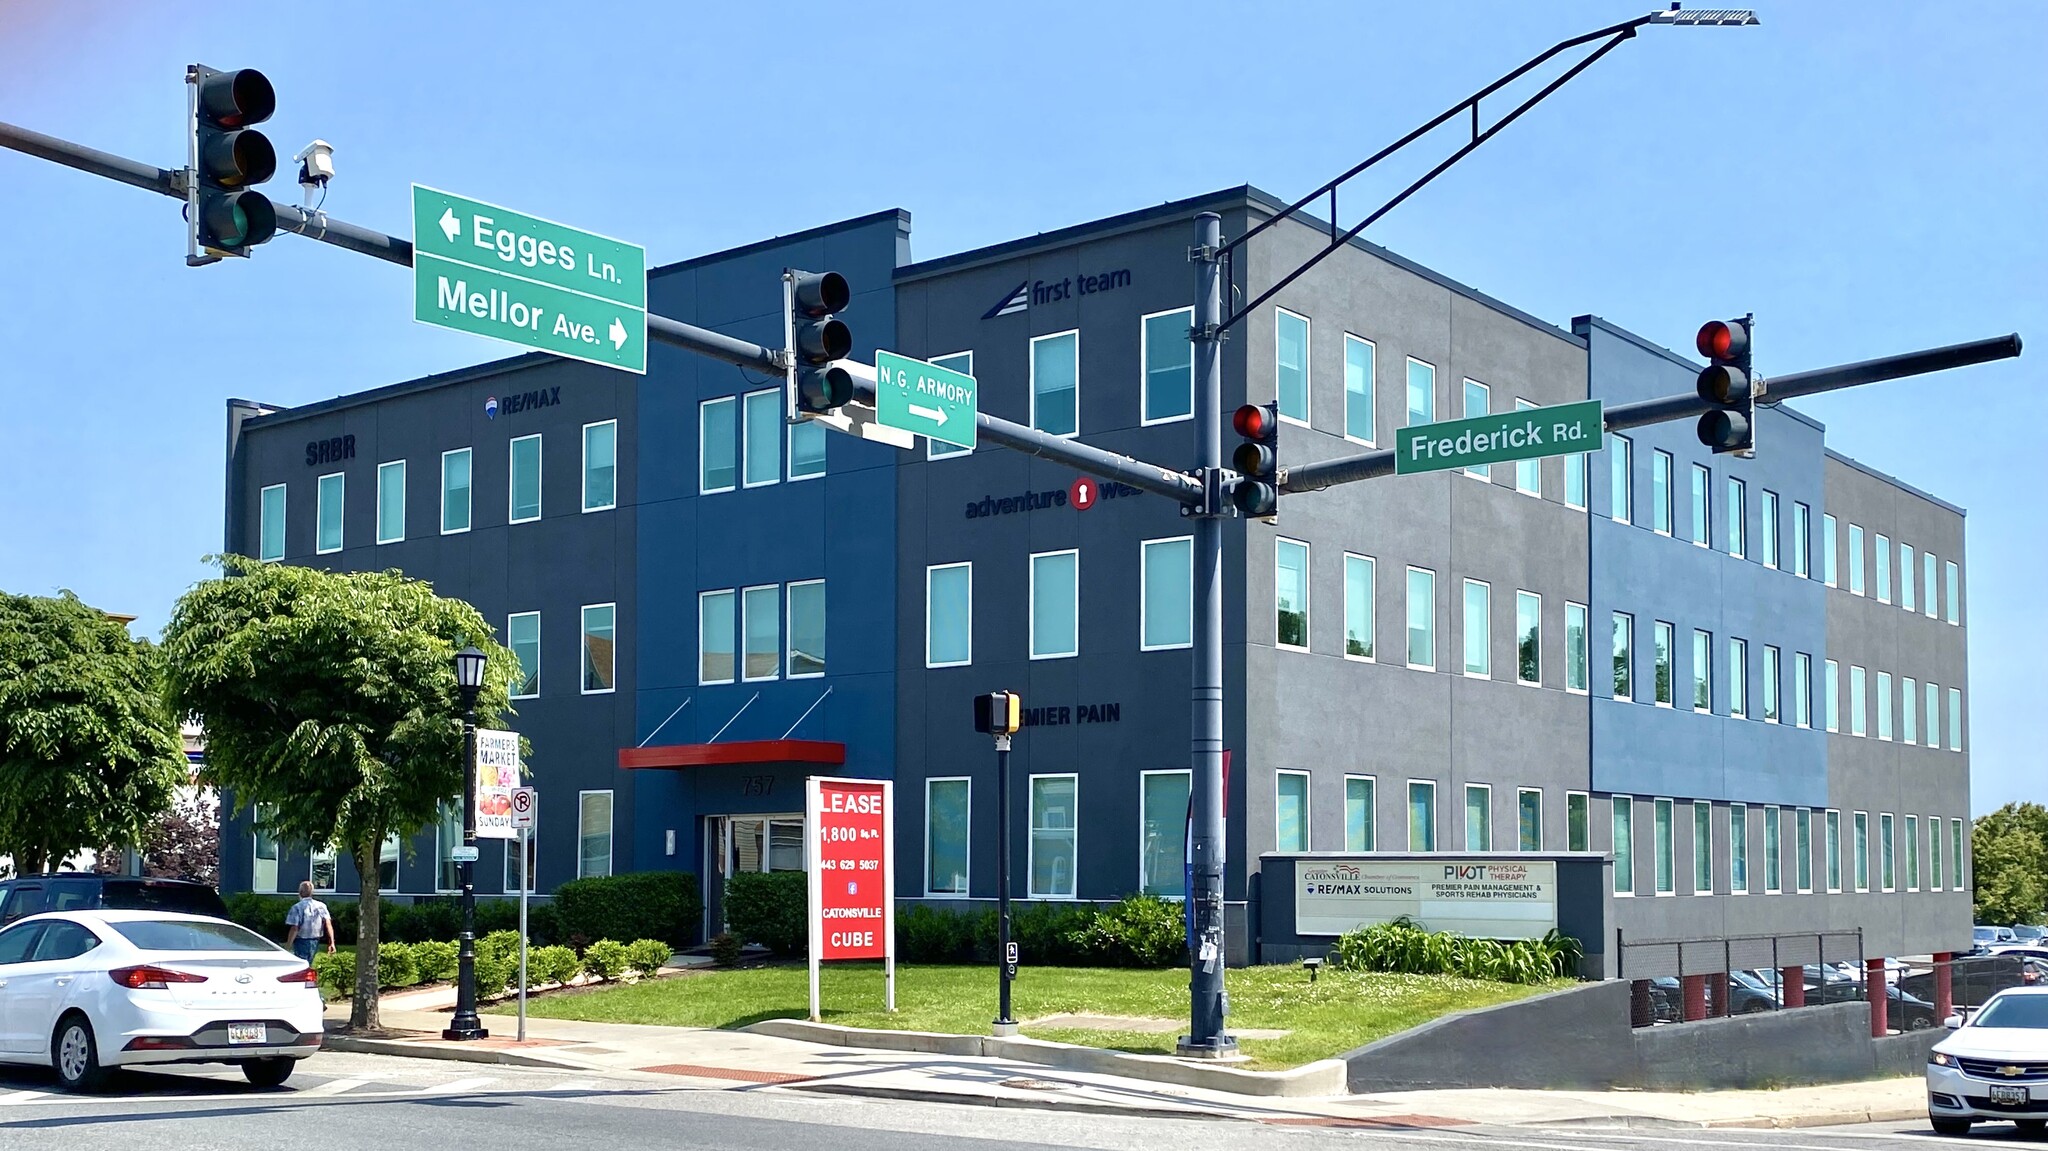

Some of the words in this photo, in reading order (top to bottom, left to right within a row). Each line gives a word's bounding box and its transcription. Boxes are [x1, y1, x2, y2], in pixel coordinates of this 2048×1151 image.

[473, 214, 576, 270] Egges
[587, 253, 622, 285] Ln.
[1032, 276, 1072, 306] first
[1077, 268, 1131, 296] team
[437, 275, 544, 331] Mellor
[552, 313, 601, 345] Ave.
[916, 375, 973, 406] ARMORY
[502, 386, 561, 416] RE/MAX
[1411, 420, 1543, 461] Frederick
[1553, 421, 1588, 443] Rd.
[305, 434, 356, 467] SRBR
[965, 488, 1067, 519] adventure
[1076, 702, 1120, 724] PAIN
[480, 737, 516, 752] FARMERS
[480, 751, 516, 766] MARKET
[742, 775, 775, 796] 757
[820, 793, 882, 814] LEASE
[820, 826, 857, 844] 1,800
[839, 859, 856, 870] 629
[859, 859, 879, 871] 5037
[1444, 866, 1487, 880] PIVOT
[1488, 865, 1528, 873] PHYSICAL
[1304, 872, 1360, 880] CATONSVILLE
[1490, 873, 1527, 881] THERAPY
[1317, 885, 1361, 895] RE/MAX
[1364, 886, 1412, 894] SOLUTIONS
[1466, 891, 1492, 899] REHAB
[1481, 884, 1534, 892] MANAGEMENT
[822, 907, 882, 918] CATONSVILLE
[831, 931, 874, 947] CUBE
